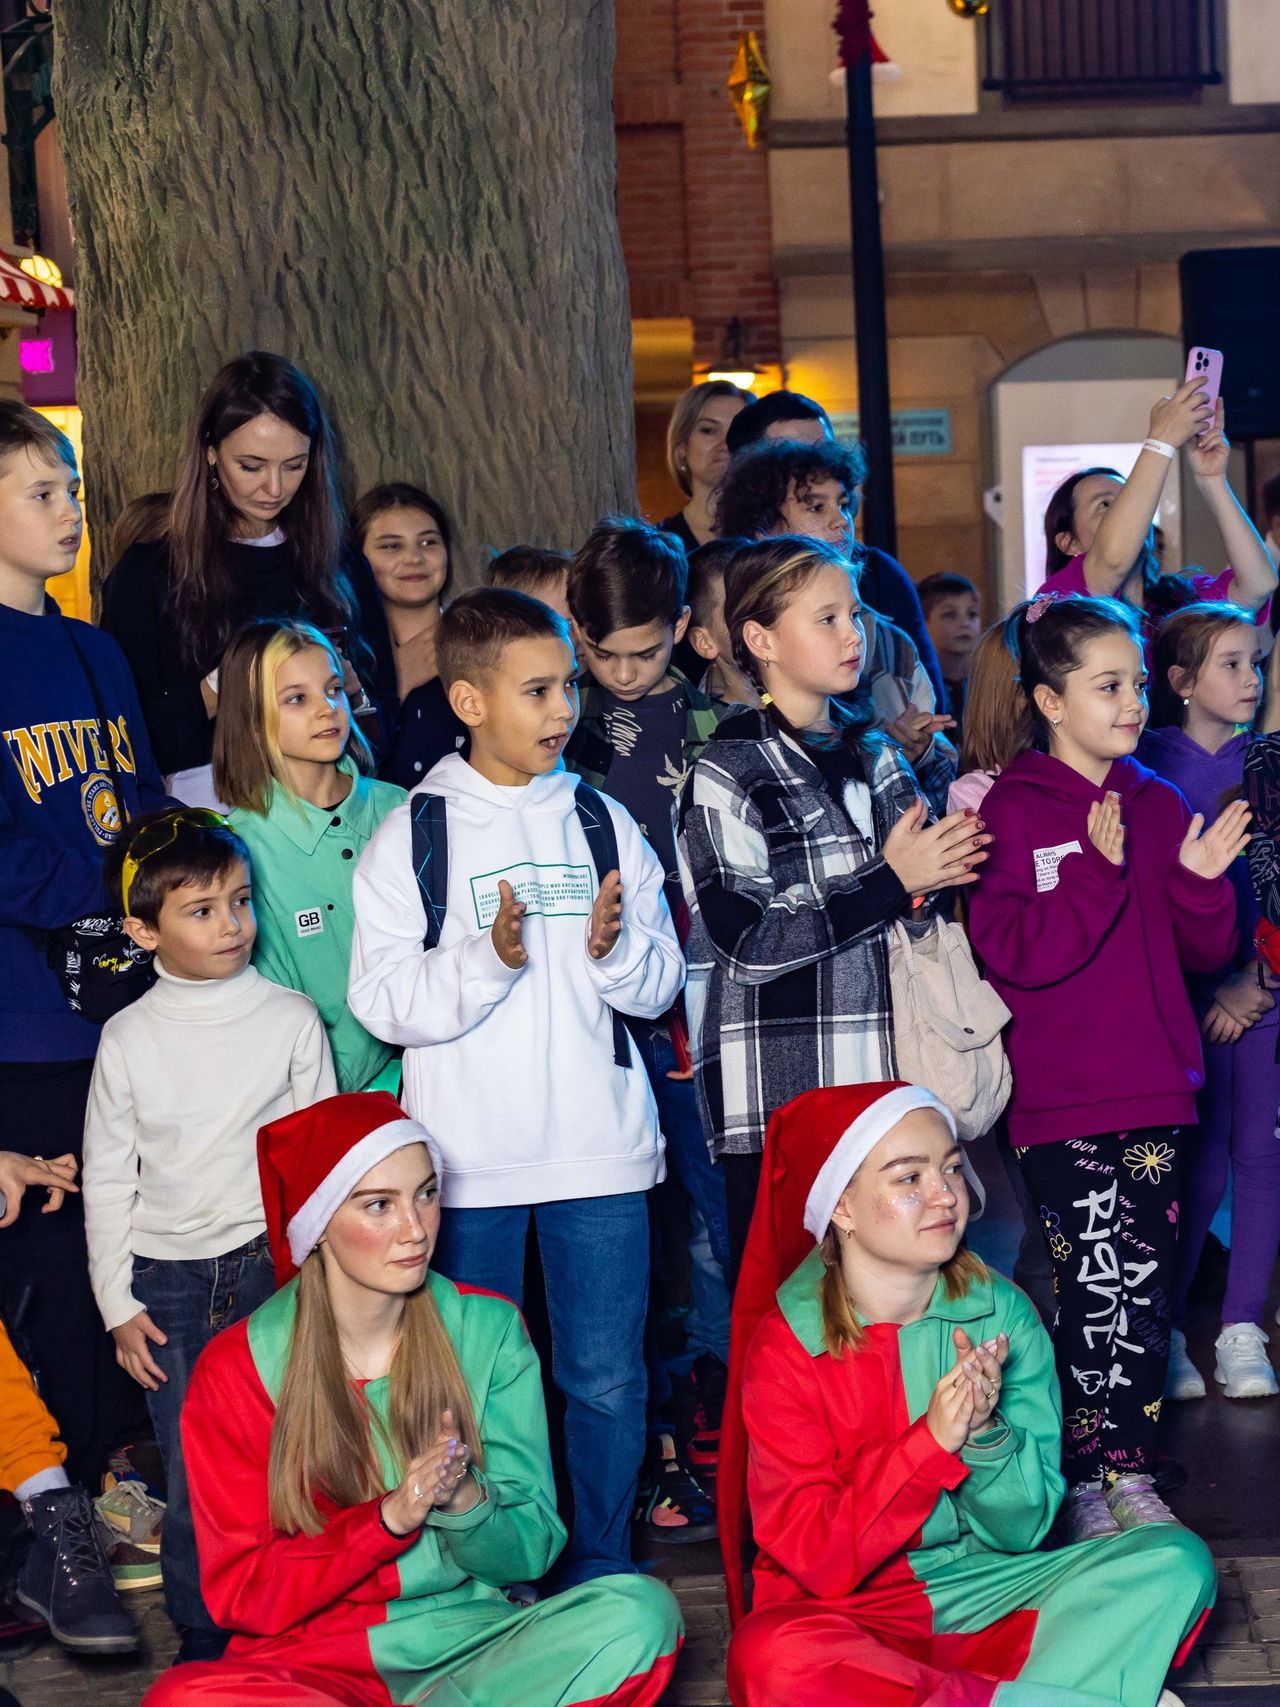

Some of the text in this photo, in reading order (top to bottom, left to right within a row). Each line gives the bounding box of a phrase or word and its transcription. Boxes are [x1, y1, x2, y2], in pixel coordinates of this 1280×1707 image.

[1041, 857, 1052, 866] TO
[298, 912, 321, 928] GB
[1064, 1138, 1098, 1155] YOUR
[1121, 1230, 1157, 1255] EART.
